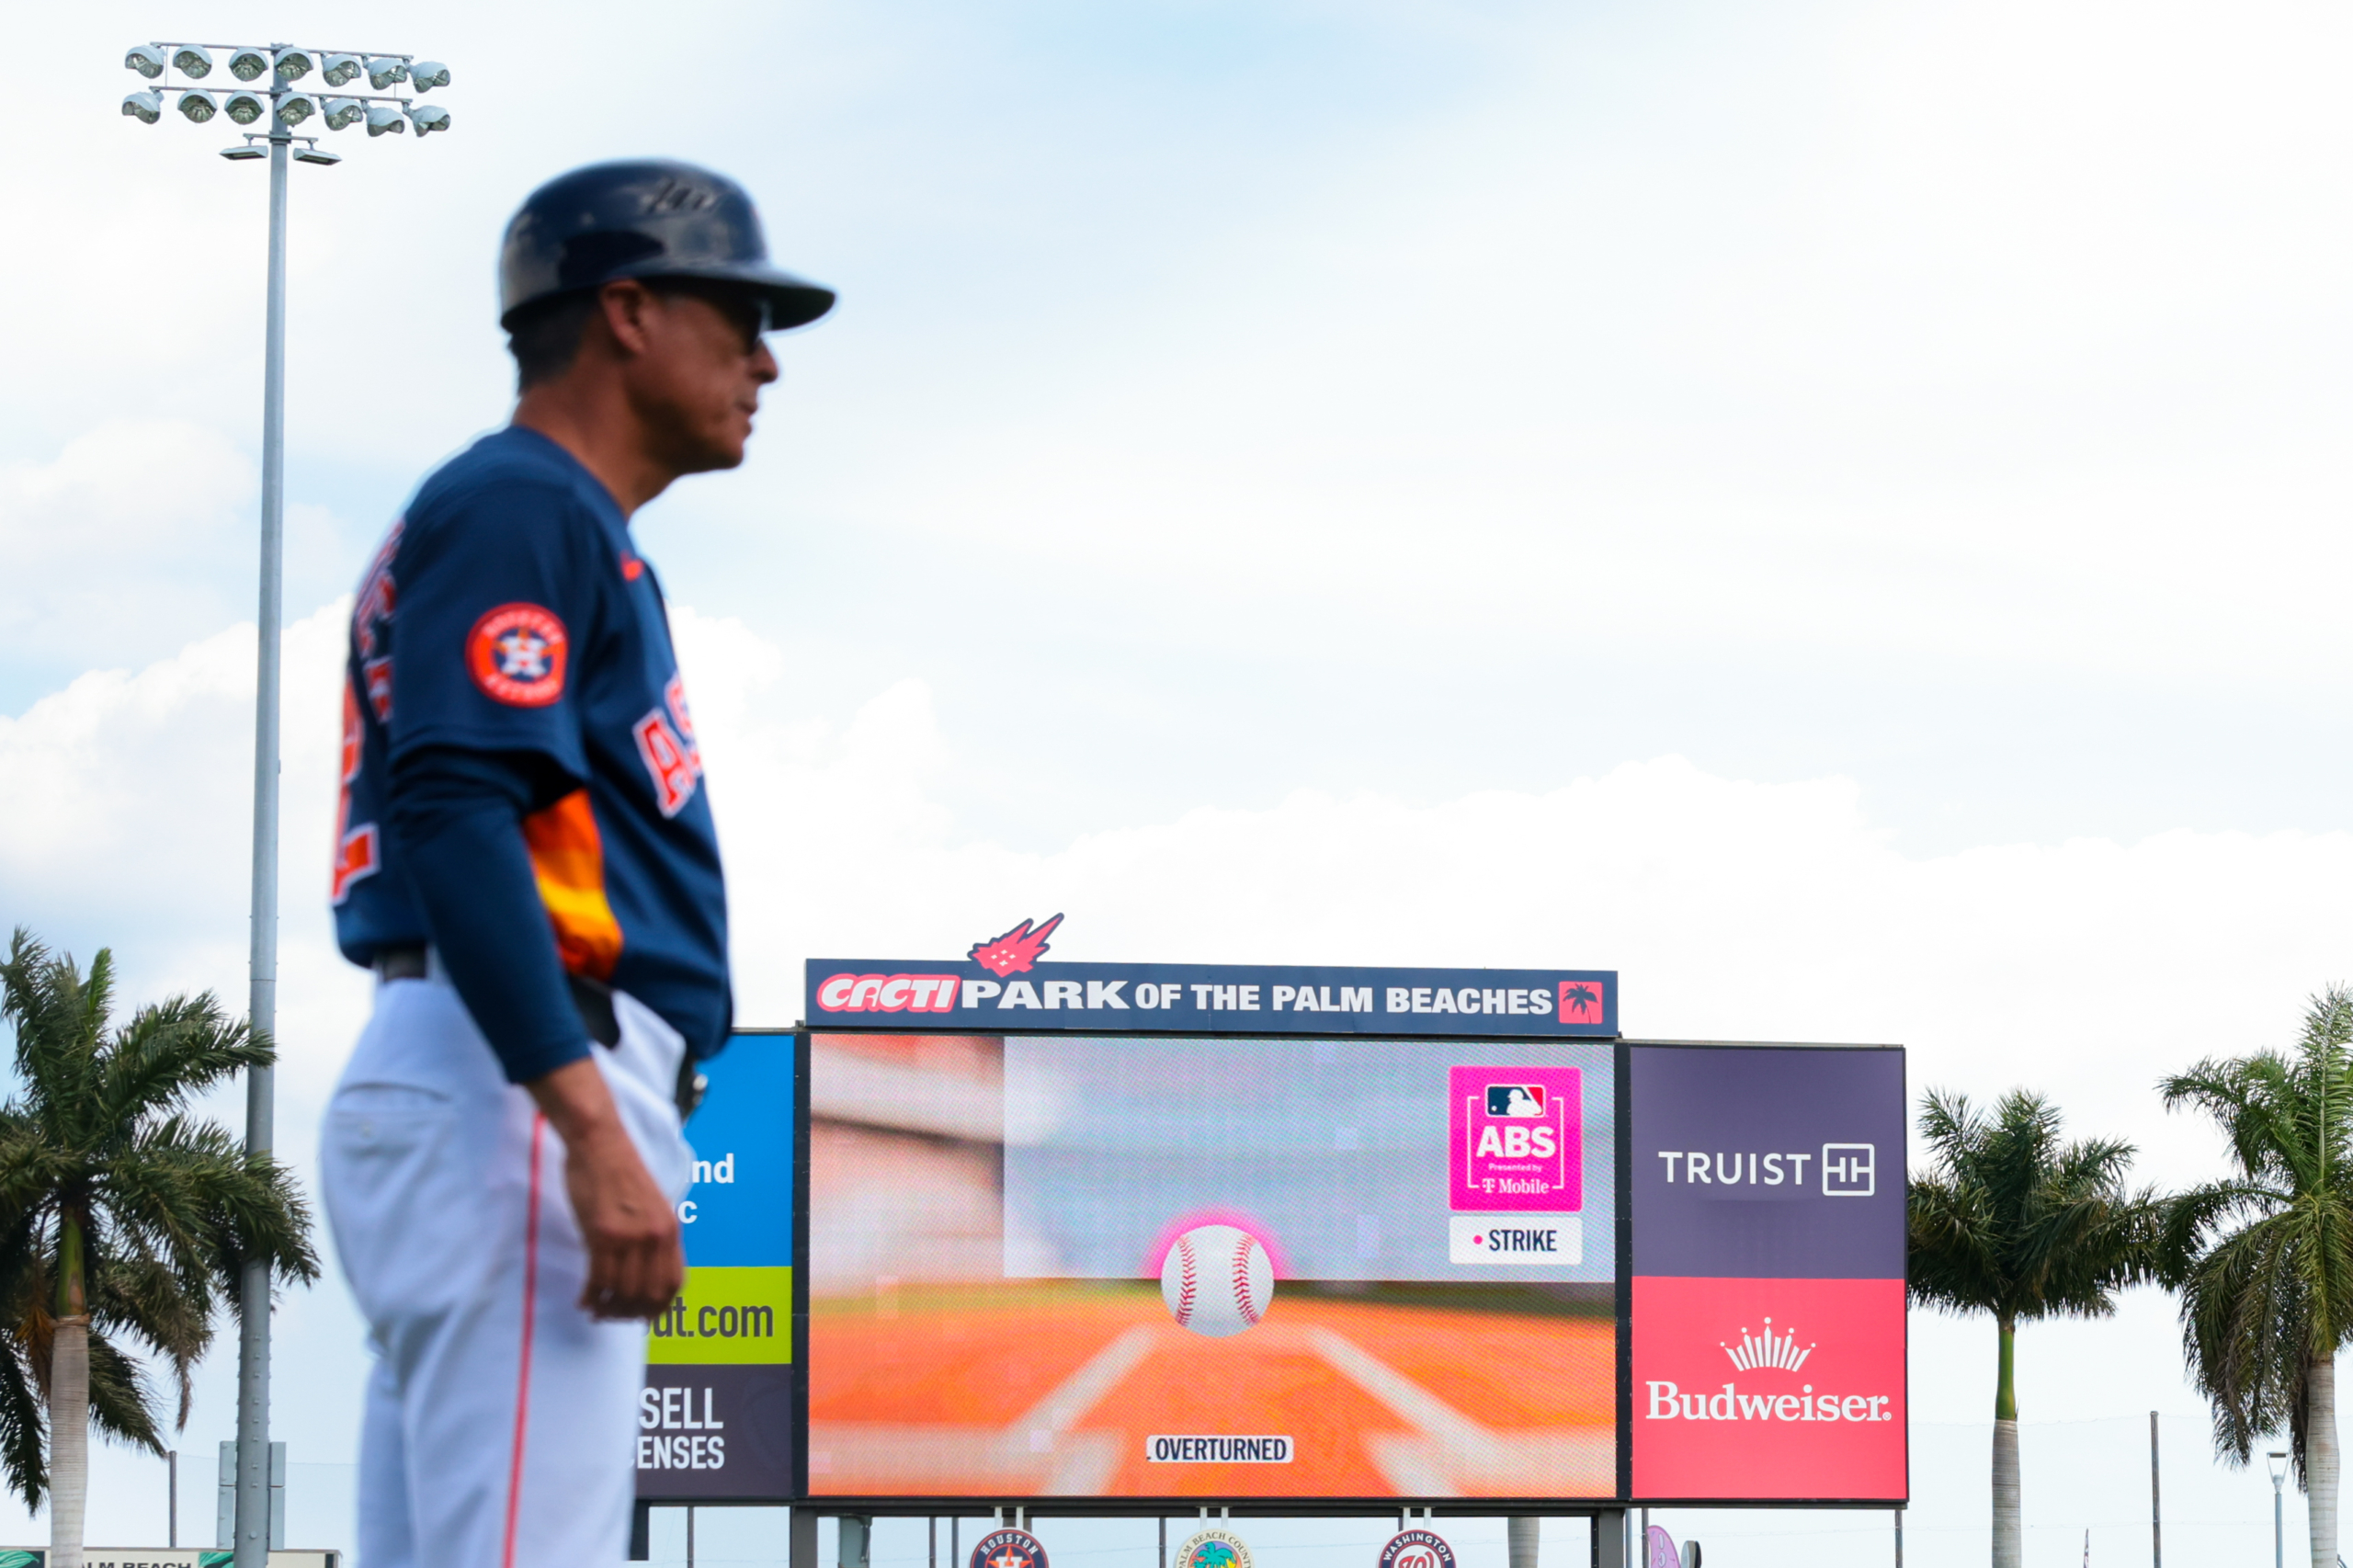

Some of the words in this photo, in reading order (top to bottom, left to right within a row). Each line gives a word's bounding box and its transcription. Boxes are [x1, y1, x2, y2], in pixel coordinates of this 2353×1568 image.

[820, 977, 957, 1009] CACTI
[962, 980, 1130, 1009] PARK
[1135, 983, 1182, 1010] OF
[1191, 984, 1260, 1011] THE
[1272, 985, 1373, 1013] PALM
[1386, 987, 1552, 1015] BEACHES
[1476, 1125, 1556, 1158] ABS
[1658, 1151, 1812, 1185] TRUIST
[1498, 1178, 1550, 1194] Mobile
[1489, 1230, 1557, 1252] STRIKE
[643, 1297, 774, 1338] ut.com
[638, 1387, 724, 1430] SELL
[634, 1436, 725, 1470] ENSES
[1155, 1438, 1287, 1460] OVERTURNED
[980, 1533, 1039, 1555] HOUSTON
[1192, 1531, 1226, 1545] BEACH
[1383, 1532, 1451, 1562] WASHINGTON
